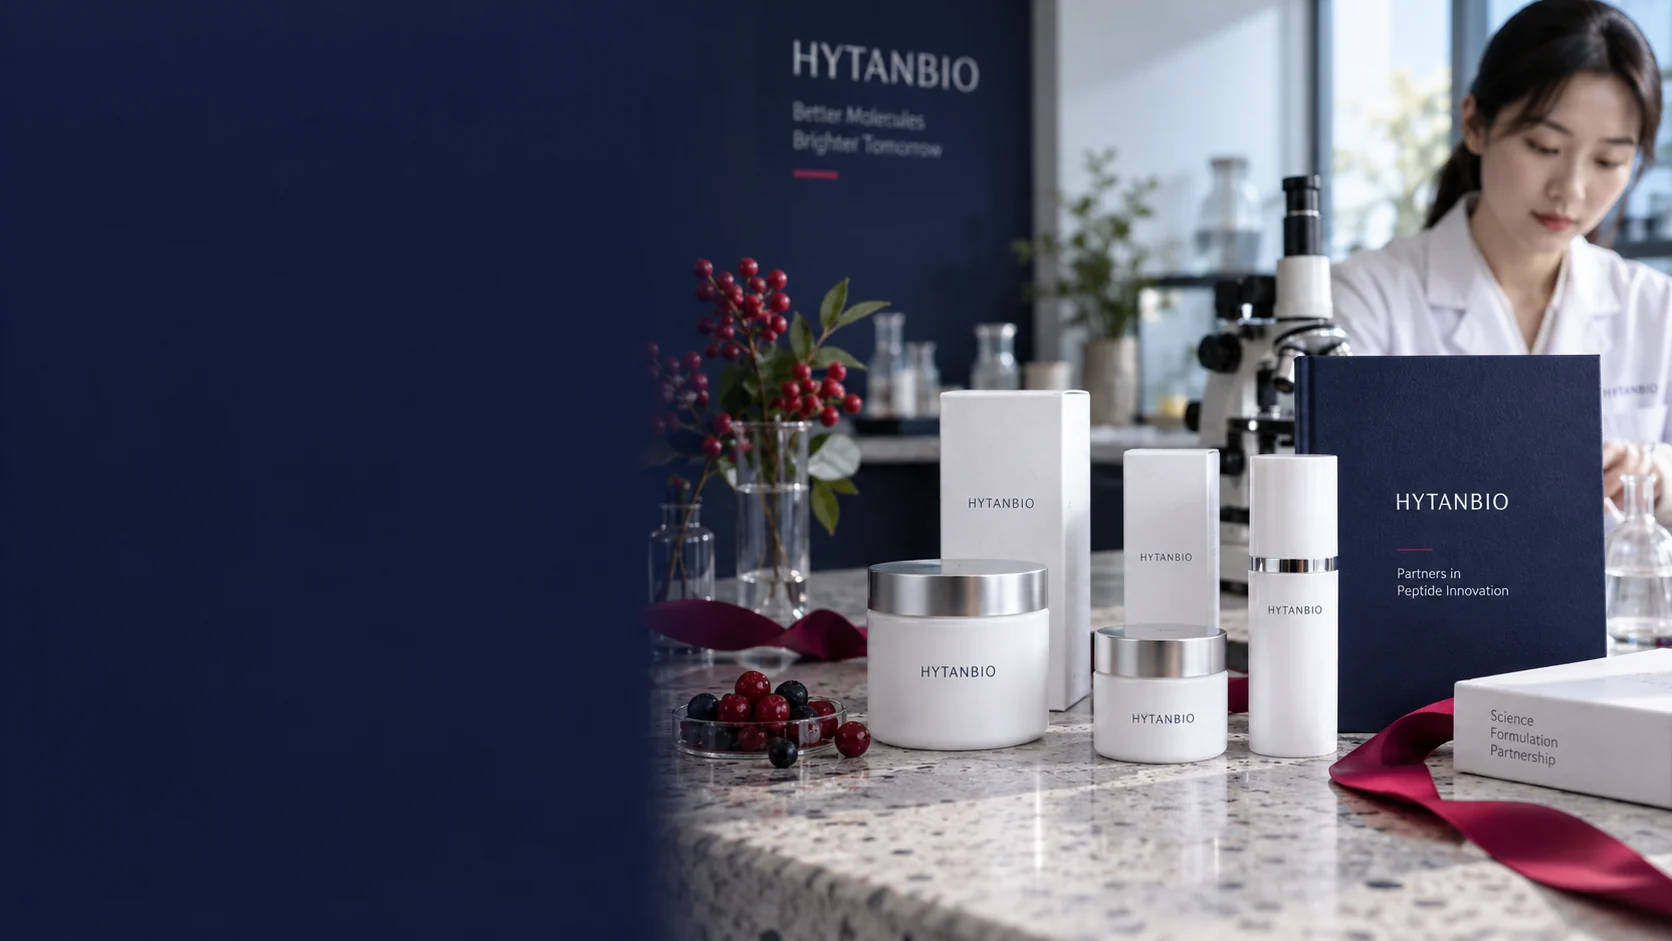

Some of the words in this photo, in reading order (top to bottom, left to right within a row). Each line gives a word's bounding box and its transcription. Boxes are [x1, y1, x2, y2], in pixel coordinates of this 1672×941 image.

[792, 39, 980, 92] HYTANBIO
[793, 100, 842, 124] Better
[845, 106, 926, 131] Molecules
[793, 129, 859, 156] Brighter
[862, 134, 943, 158] Tomorrow
[968, 497, 1035, 509] HYTANBIO
[1396, 492, 1509, 511] HYTANBIO
[1140, 552, 1193, 562] HYTANBIO
[1397, 567, 1447, 579] Partners
[1450, 567, 1461, 579] in
[1397, 585, 1443, 599] Peptide
[1446, 585, 1509, 596] Innovation
[1267, 605, 1323, 615] HYTANBIO
[920, 665, 996, 678] HYTANBIO
[1131, 713, 1195, 725] HYTANBIO
[1490, 709, 1534, 727] Science
[1490, 727, 1559, 749] Formulation
[1490, 744, 1557, 768] Partnership
